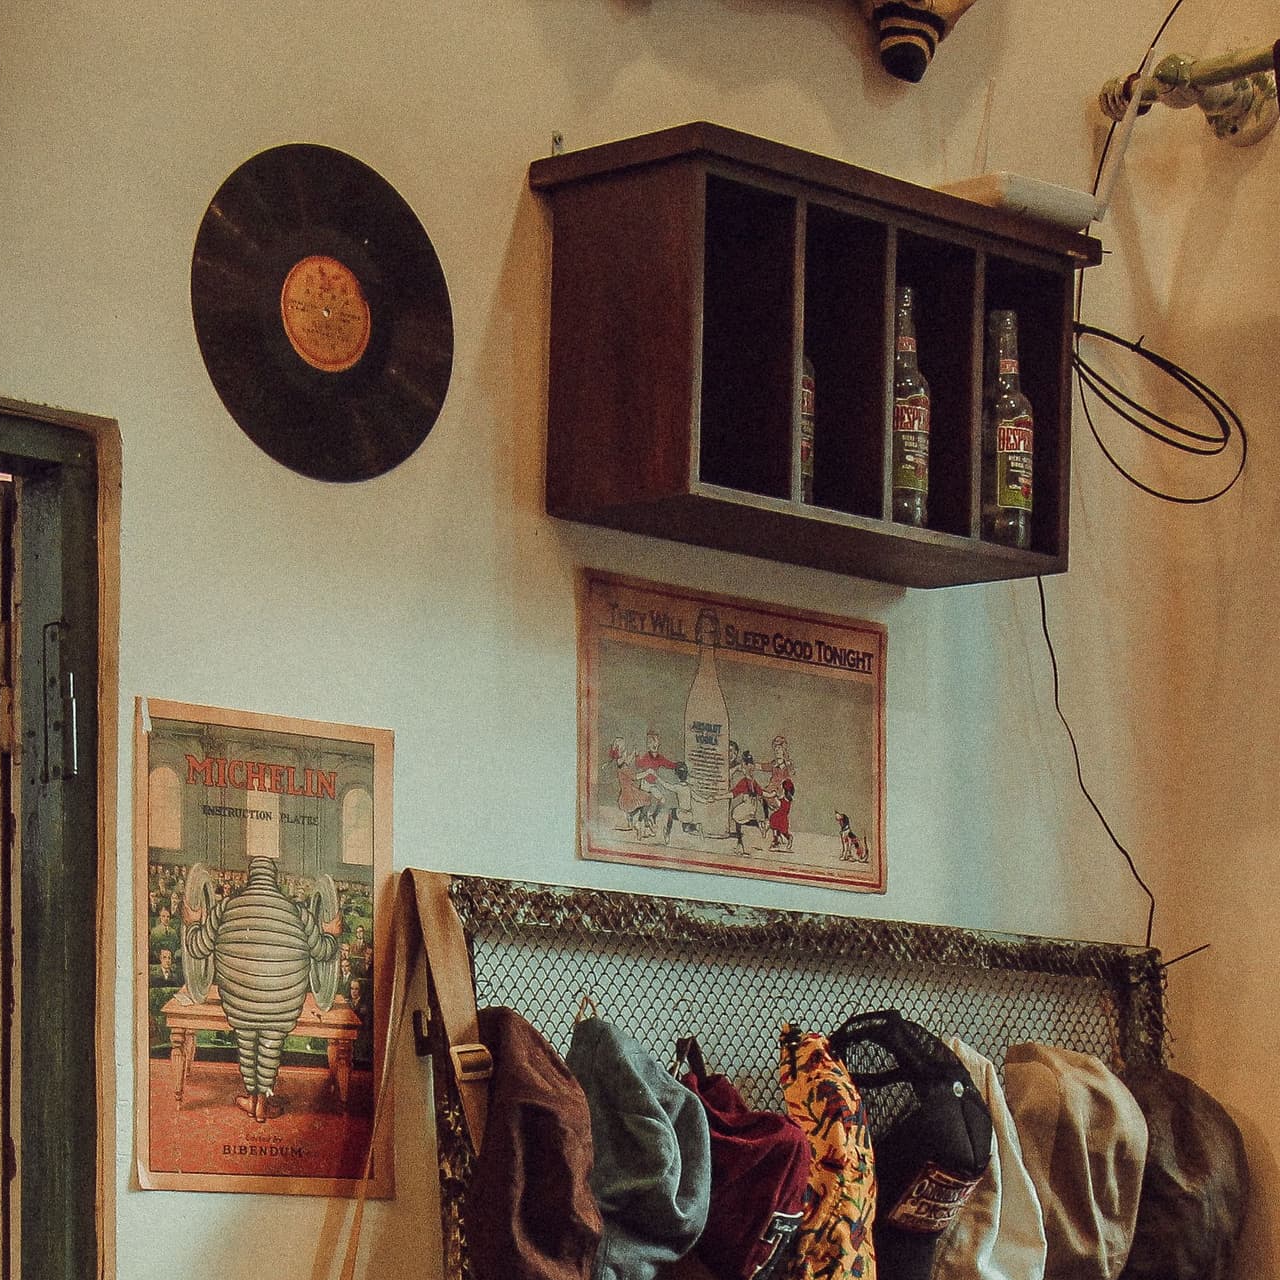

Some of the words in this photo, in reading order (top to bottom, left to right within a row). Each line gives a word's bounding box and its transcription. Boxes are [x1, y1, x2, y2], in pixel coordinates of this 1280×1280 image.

[650, 610, 687, 641] WILL
[725, 625, 770, 650] SLEEP
[772, 632, 813, 661] GOOD
[815, 639, 875, 673] TONIGHT
[184, 753, 337, 800] MICHELIN
[200, 803, 272, 821] INSTRUCTION
[279, 811, 319, 826] PLATES
[222, 1144, 304, 1158] BIBENDUM
